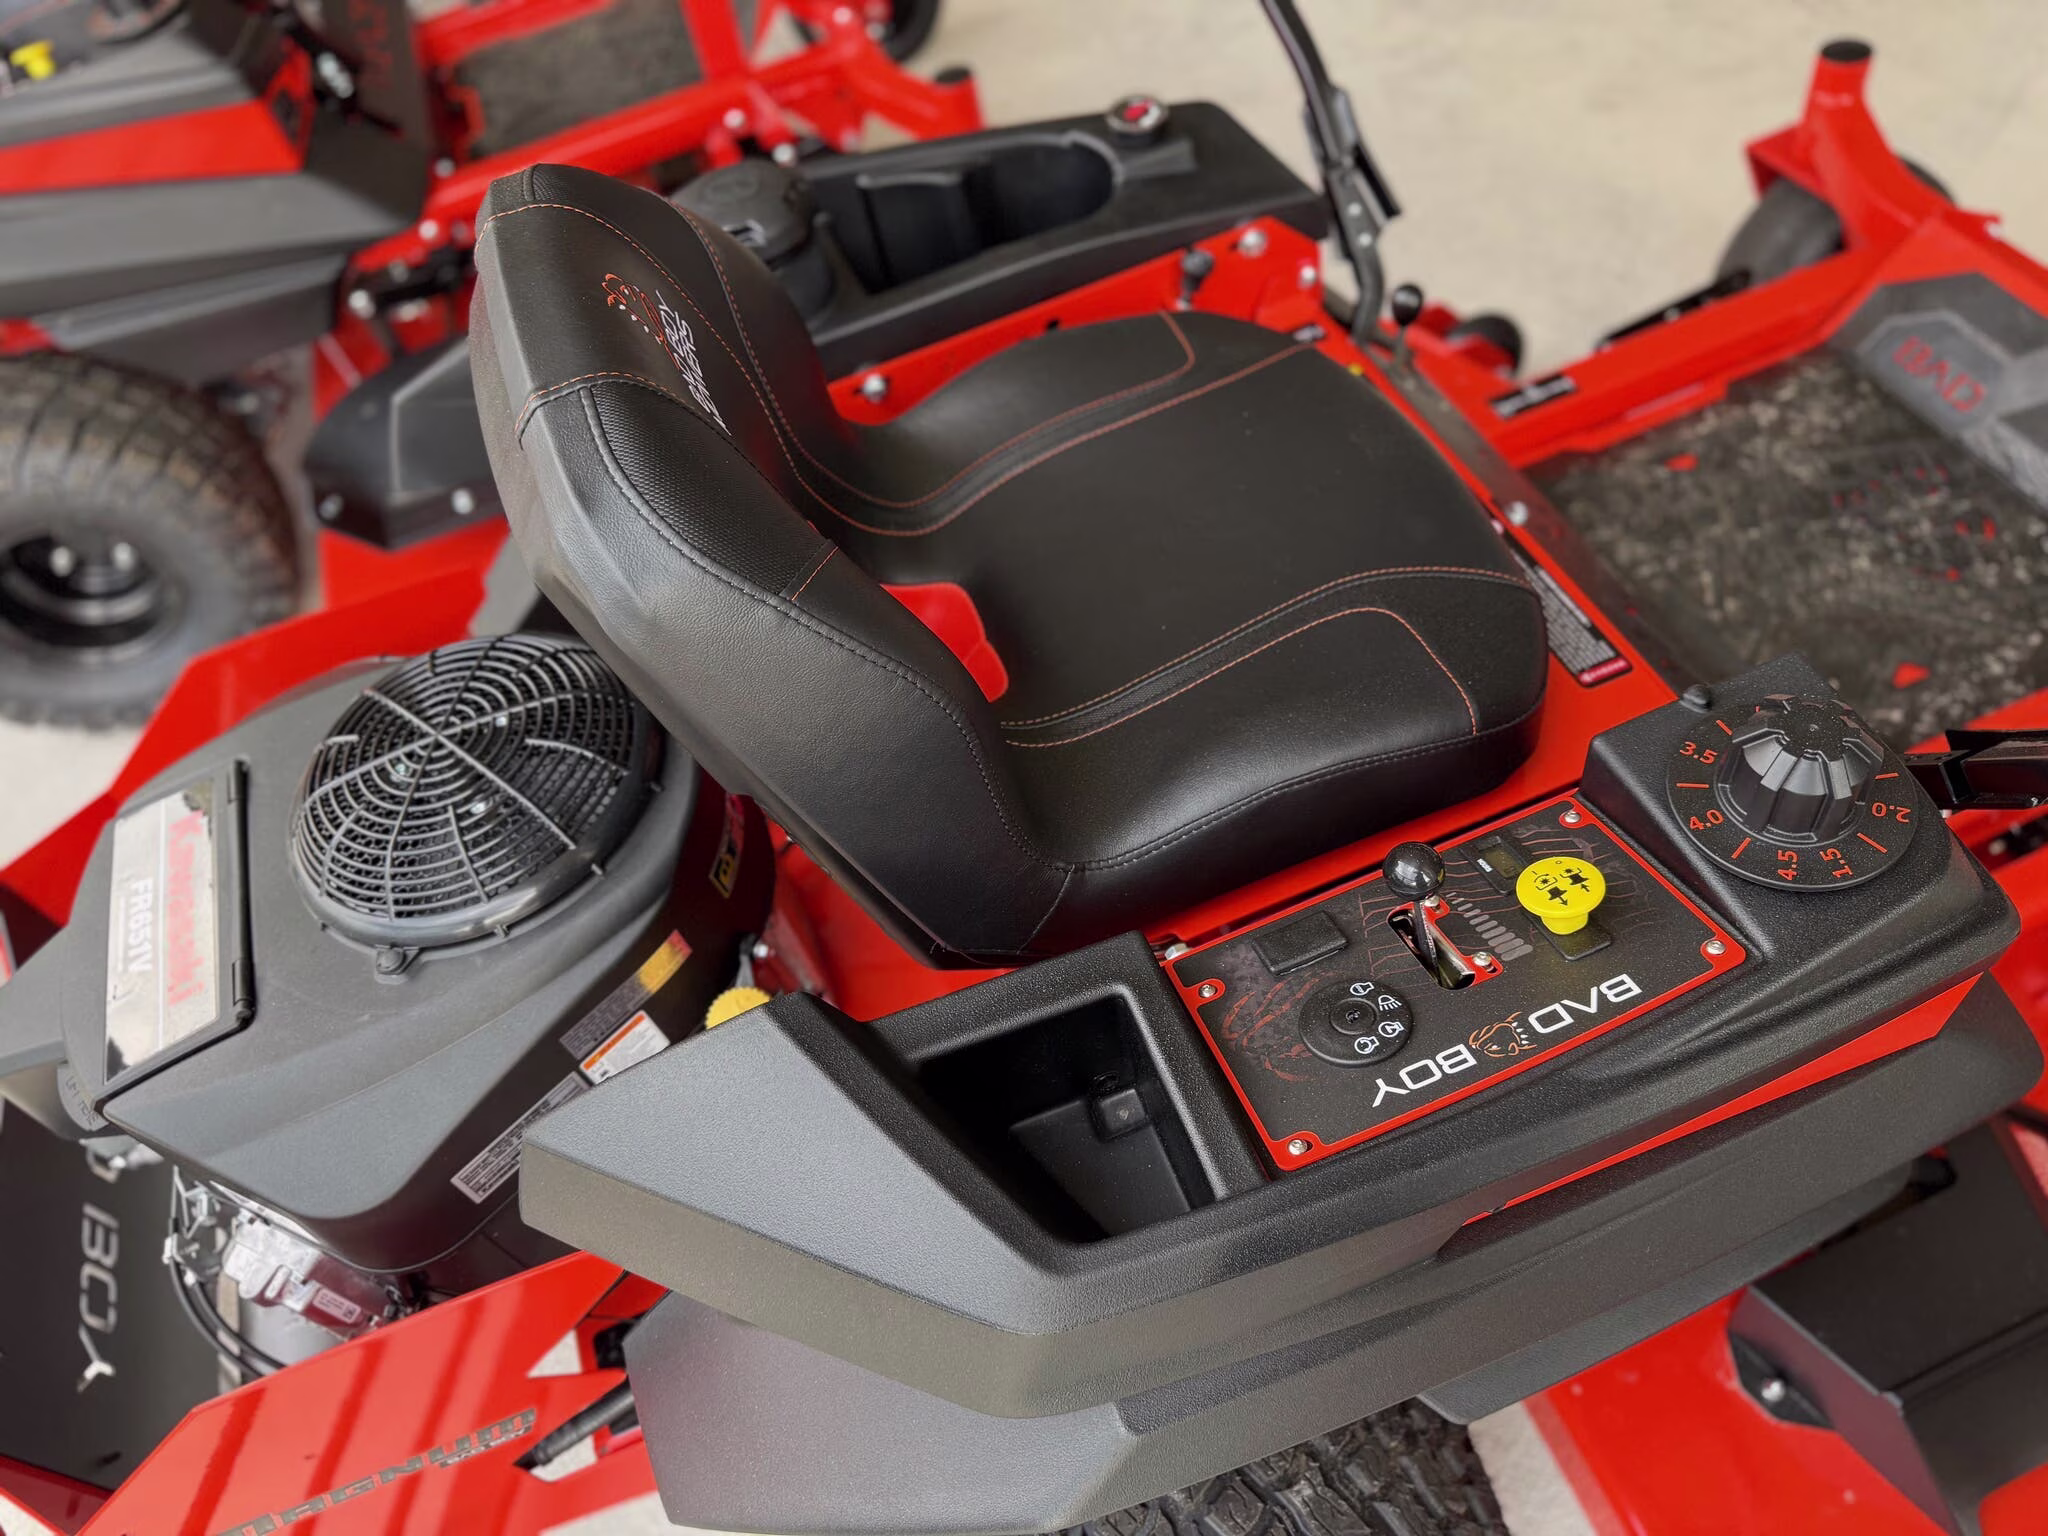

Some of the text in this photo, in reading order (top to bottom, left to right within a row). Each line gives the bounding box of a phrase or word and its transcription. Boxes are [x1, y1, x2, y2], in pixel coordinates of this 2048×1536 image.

[655, 289, 712, 415] BAD BOY
[674, 311, 733, 437] MOWERS
[1892, 336, 1986, 414] BAD
[1679, 740, 1718, 765] 3.5
[1688, 809, 1724, 832] 4.0
[1871, 801, 1912, 824] 2.0
[1777, 849, 1798, 881] 4.5
[1819, 847, 1854, 879] 1.5
[127, 878, 157, 973] FR651V
[167, 808, 207, 1007] Kawasaki
[1371, 972, 1643, 1108] BAD BOY
[77, 1202, 121, 1394] BOY
